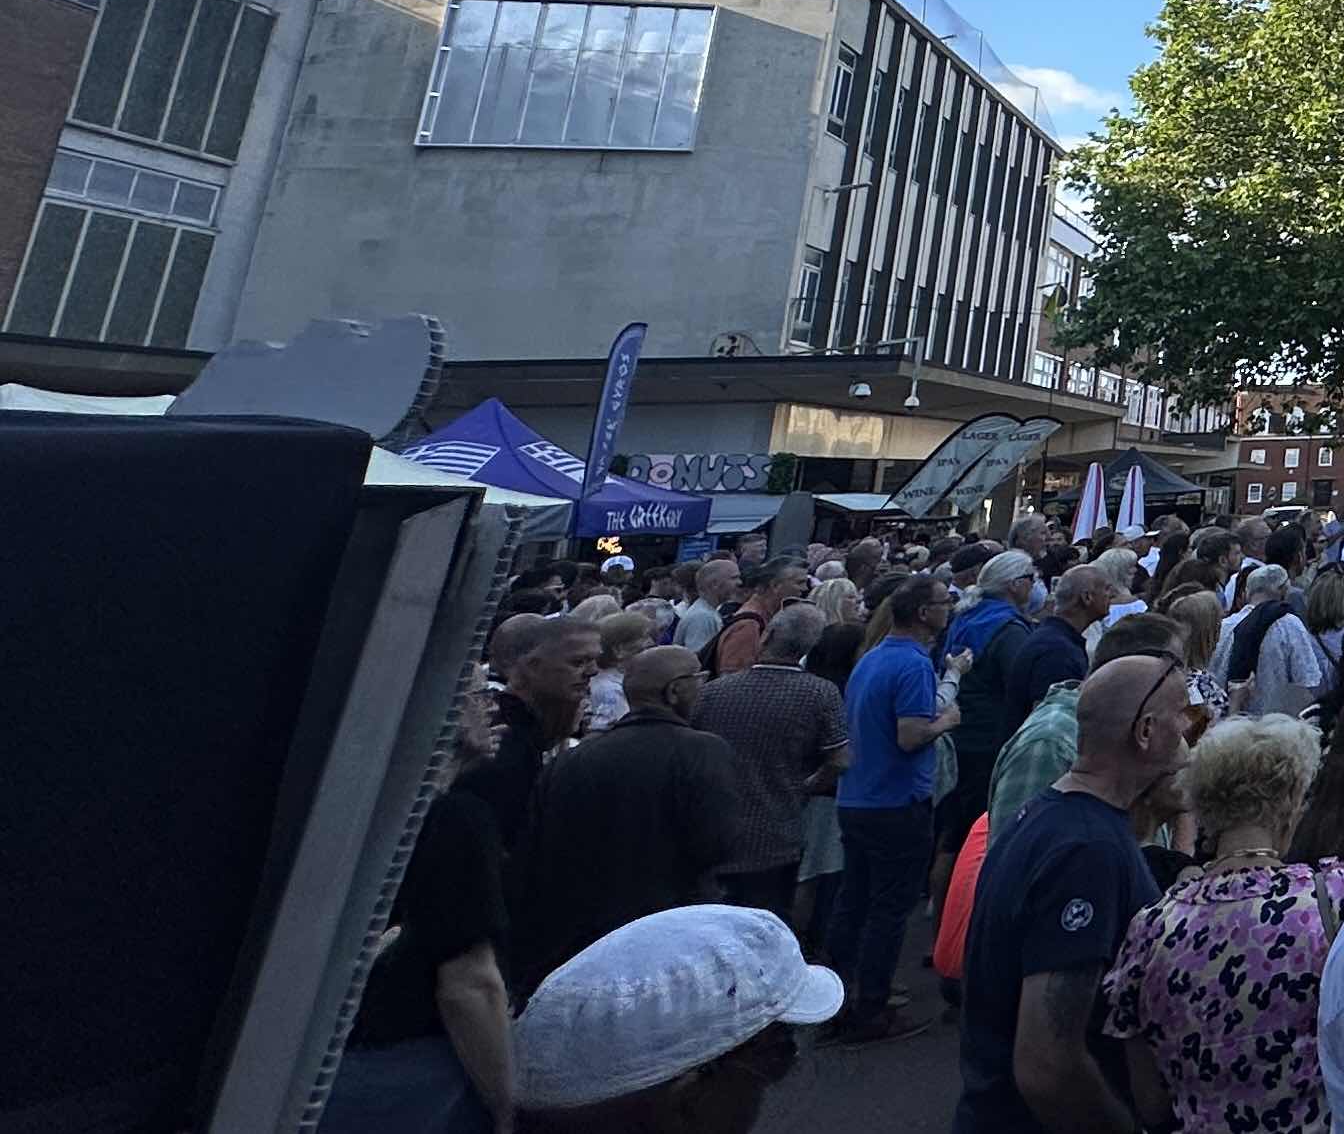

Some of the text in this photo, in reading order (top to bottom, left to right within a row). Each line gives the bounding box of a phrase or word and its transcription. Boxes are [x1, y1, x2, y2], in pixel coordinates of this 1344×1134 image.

[961, 432, 998, 441] LAGER
[1008, 433, 1041, 441] LAGER
[626, 454, 773, 491] DONUTS
[903, 486, 937, 499] WINE
[955, 484, 985, 496] WINE
[606, 509, 626, 531] THE
